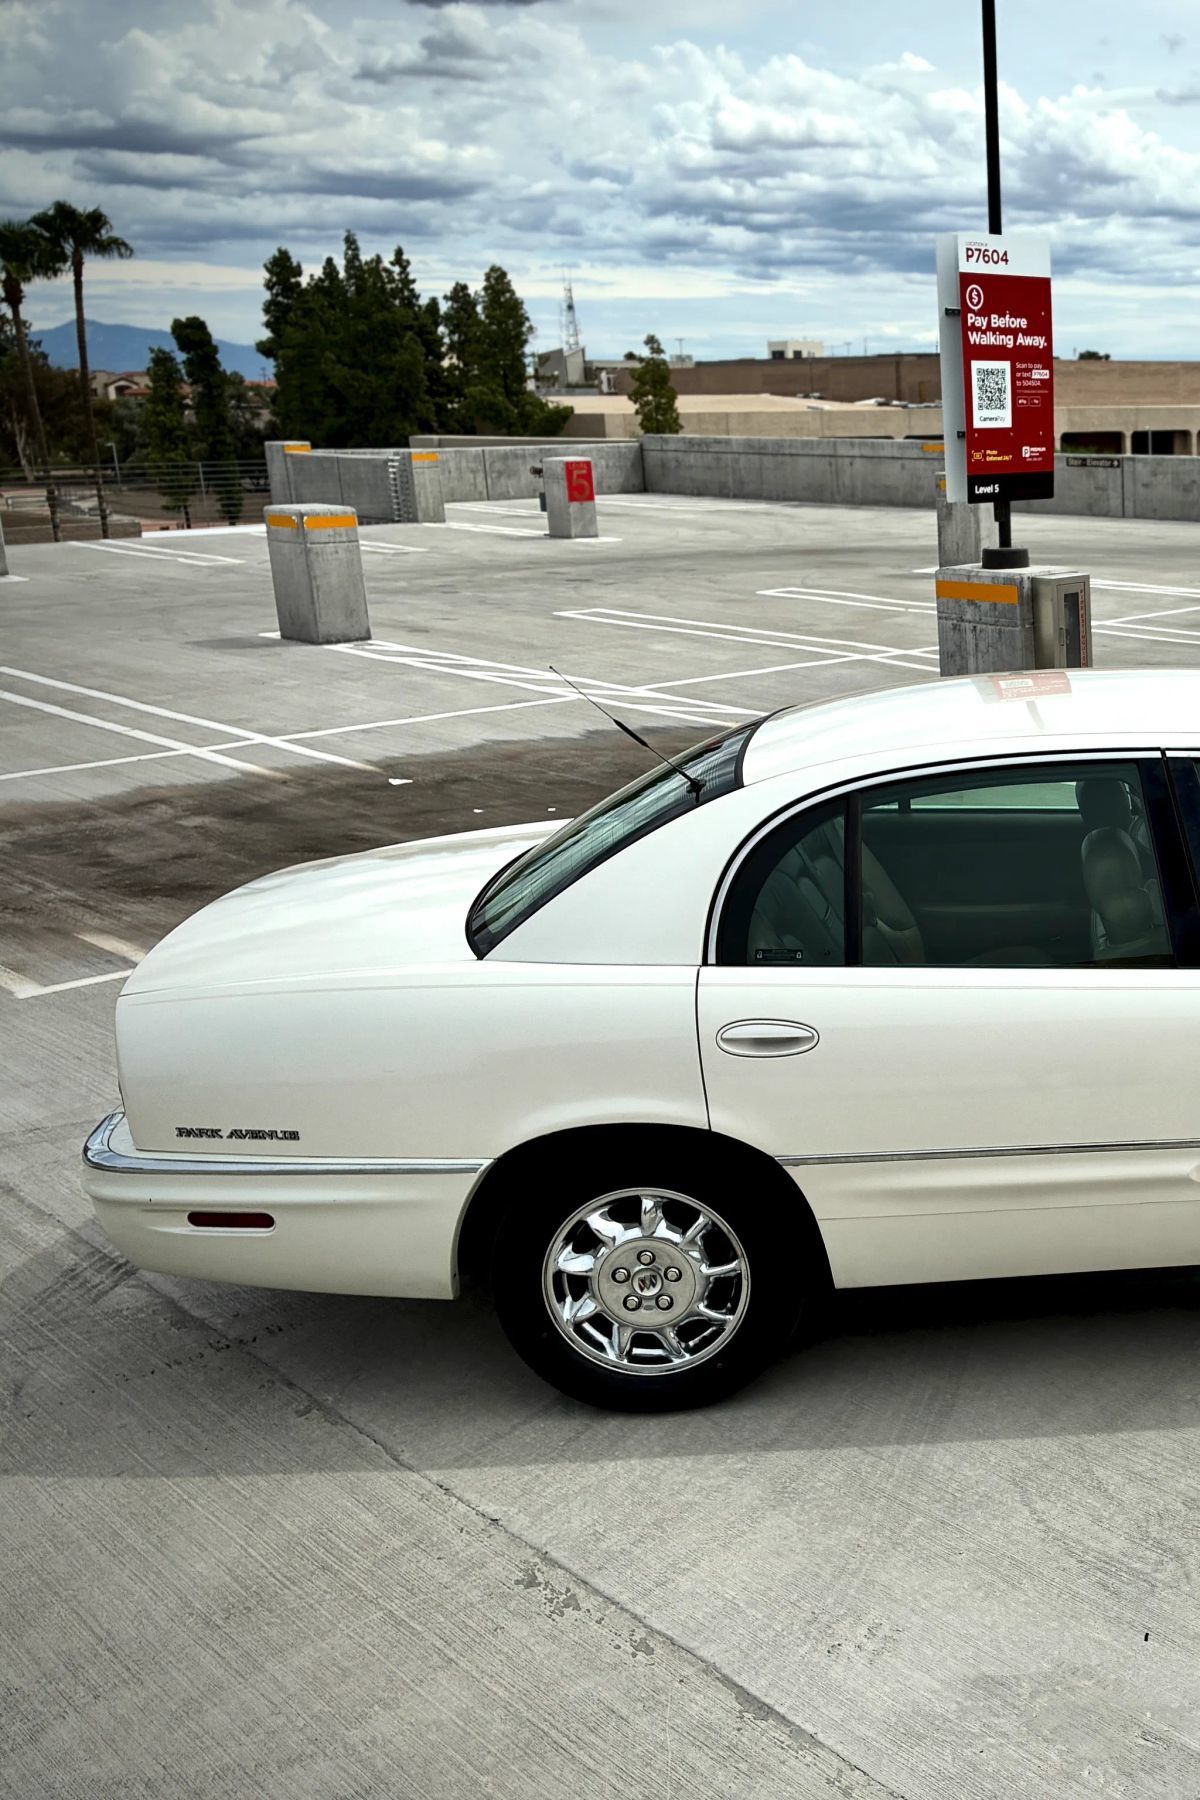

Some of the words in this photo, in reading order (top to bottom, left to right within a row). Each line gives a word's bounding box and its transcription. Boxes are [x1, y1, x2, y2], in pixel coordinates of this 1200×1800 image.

[966, 247, 1009, 265] P7604
[967, 313, 989, 330] Pay
[990, 314, 1027, 328] Before
[968, 331, 1014, 348] Walking
[1016, 332, 1048, 349] Away.
[1086, 458, 1112, 467] Elevator
[572, 469, 591, 499] 5
[974, 484, 994, 495] Level
[994, 483, 1000, 493] 5
[175, 1127, 223, 1140] PARK
[226, 1128, 300, 1141] AVENUE
